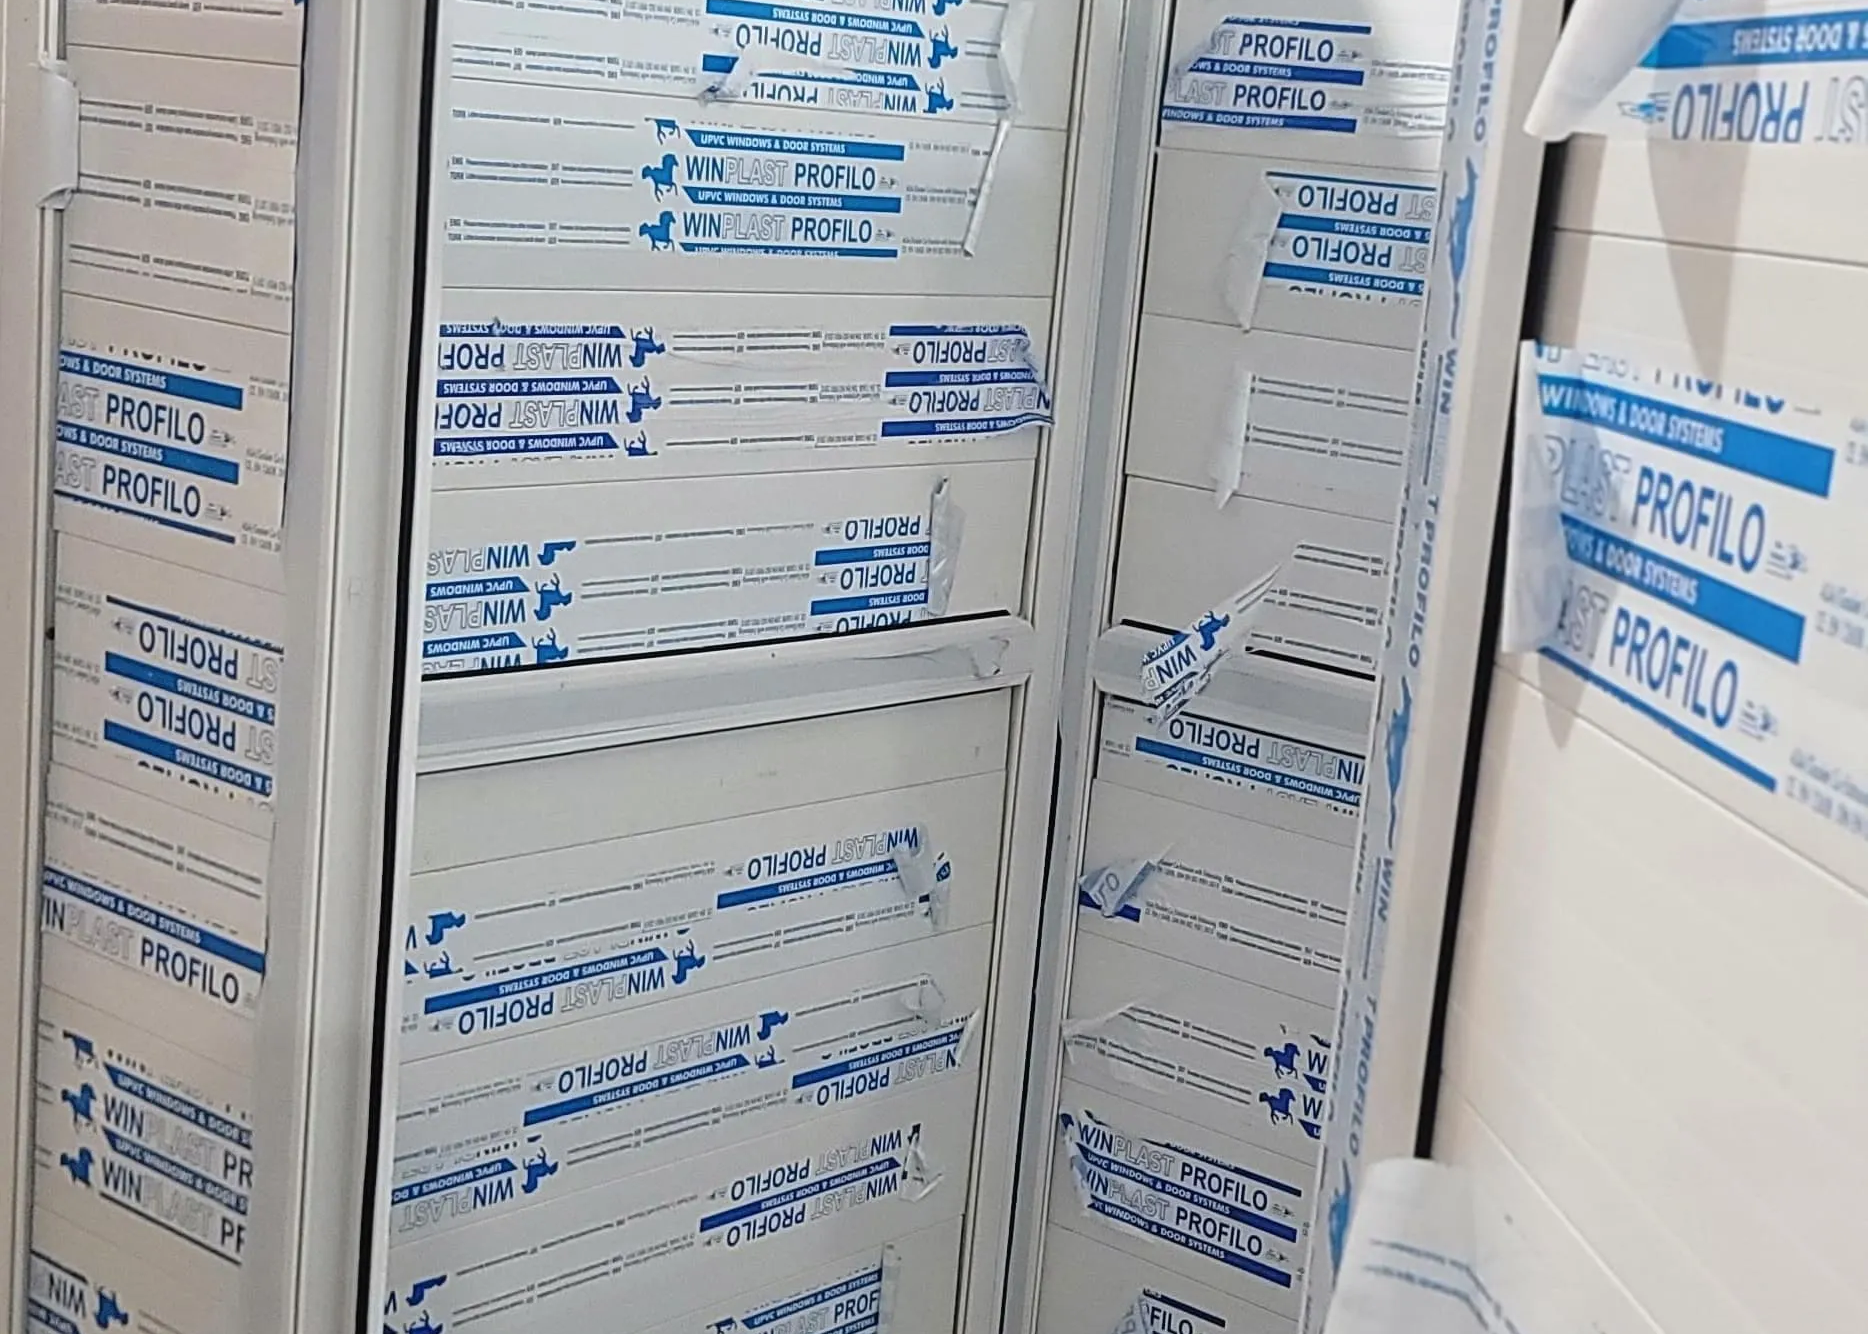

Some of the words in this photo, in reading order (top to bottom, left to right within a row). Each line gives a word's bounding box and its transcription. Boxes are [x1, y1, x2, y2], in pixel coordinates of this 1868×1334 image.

[1239, 34, 1334, 62] PROFILO
[1733, 27, 1790, 55] SYSTEMS
[1793, 24, 1840, 50] DOOR
[1233, 85, 1326, 110] PROFILO
[1672, 80, 1809, 143] PROFILO
[701, 134, 724, 146] UPVC
[728, 136, 770, 149] WINDOWS
[774, 139, 781, 150] &
[783, 140, 806, 151] DOOR
[810, 142, 845, 153] SYSTEMS
[794, 164, 875, 190] PROFILO
[699, 191, 722, 202] UPVC
[725, 192, 768, 204] WINDOWS
[771, 195, 778, 204] &
[781, 195, 804, 206] DOOR
[807, 196, 842, 207] SYSTEMS
[1299, 185, 1398, 215] PROFILO
[791, 218, 872, 243] PROFILO
[1293, 235, 1392, 268] PROFILO
[913, 341, 986, 364] PROFILO
[444, 383, 485, 393] SYSTEMS
[488, 383, 518, 393] DOOR
[521, 383, 527, 392] &
[531, 382, 578, 392] WINDOWS
[581, 381, 607, 391] UPVC
[909, 392, 979, 413] PROFILO
[106, 392, 205, 445] PROFILO
[1618, 405, 1627, 428] &
[1631, 407, 1664, 436] DOOR
[1668, 419, 1723, 455] SYSTEMS
[102, 465, 201, 517] PROFILO
[845, 517, 921, 541] PROFILO
[1633, 464, 1766, 574] PROFILO
[431, 583, 483, 596] WINDOWS
[487, 581, 513, 592] UPVC
[840, 563, 916, 590] PROFILO
[1409, 519, 1437, 669] PROFILO
[140, 620, 238, 680] PROFILO
[428, 639, 480, 653] WINDOWS
[483, 636, 509, 648] UPVC
[1610, 607, 1738, 729] PROFILO
[138, 692, 236, 752] PROFILO
[1169, 718, 1259, 758] PROFILO
[748, 846, 827, 880] PROFILO
[141, 937, 239, 1004] PROFILO
[459, 991, 554, 1035] PROFILO
[559, 1049, 647, 1093] PROFILO
[818, 1068, 890, 1105] PROFILO
[731, 1158, 811, 1201] PROFILO
[1181, 1162, 1268, 1211] PROFILO
[1176, 1209, 1263, 1257] PROFILO
